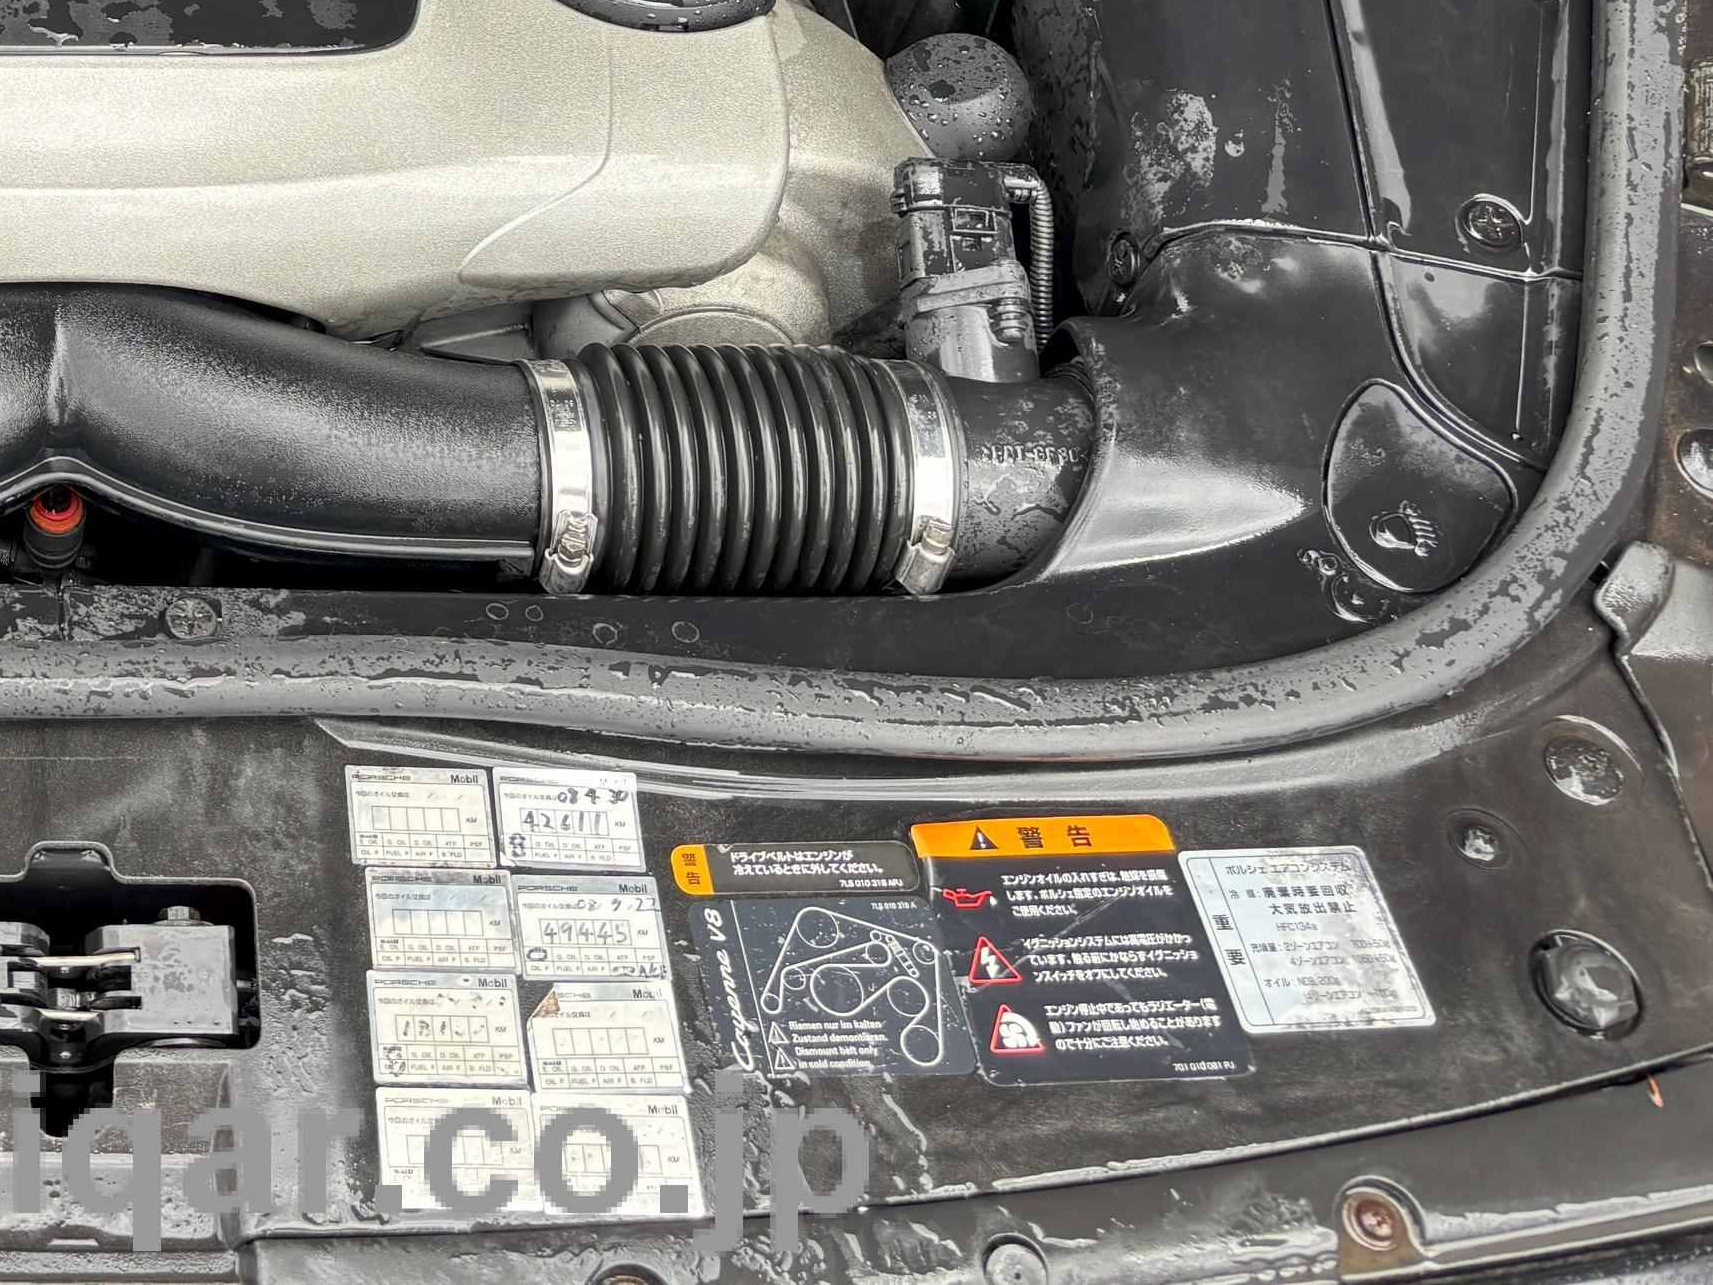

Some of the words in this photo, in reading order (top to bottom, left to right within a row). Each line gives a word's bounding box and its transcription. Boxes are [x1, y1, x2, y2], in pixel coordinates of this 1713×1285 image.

[451, 774, 478, 784] Mobil
[1017, 824, 1092, 849] 警告
[473, 875, 501, 884] Mobil
[619, 884, 647, 893] Mobil
[703, 908, 727, 942] V8
[1212, 914, 1246, 966] 重要
[478, 978, 507, 988] Mobil
[788, 1021, 823, 1030] Riemen
[853, 1019, 882, 1029] kalten
[792, 1033, 829, 1043] Zustand
[795, 1046, 832, 1056] Dismount
[839, 1046, 857, 1055] belt
[858, 1046, 878, 1056] only
[799, 1060, 808, 1068] in
[809, 1059, 827, 1068] cold
[492, 1096, 522, 1106] Mobil
[648, 1104, 678, 1114] Mobil
